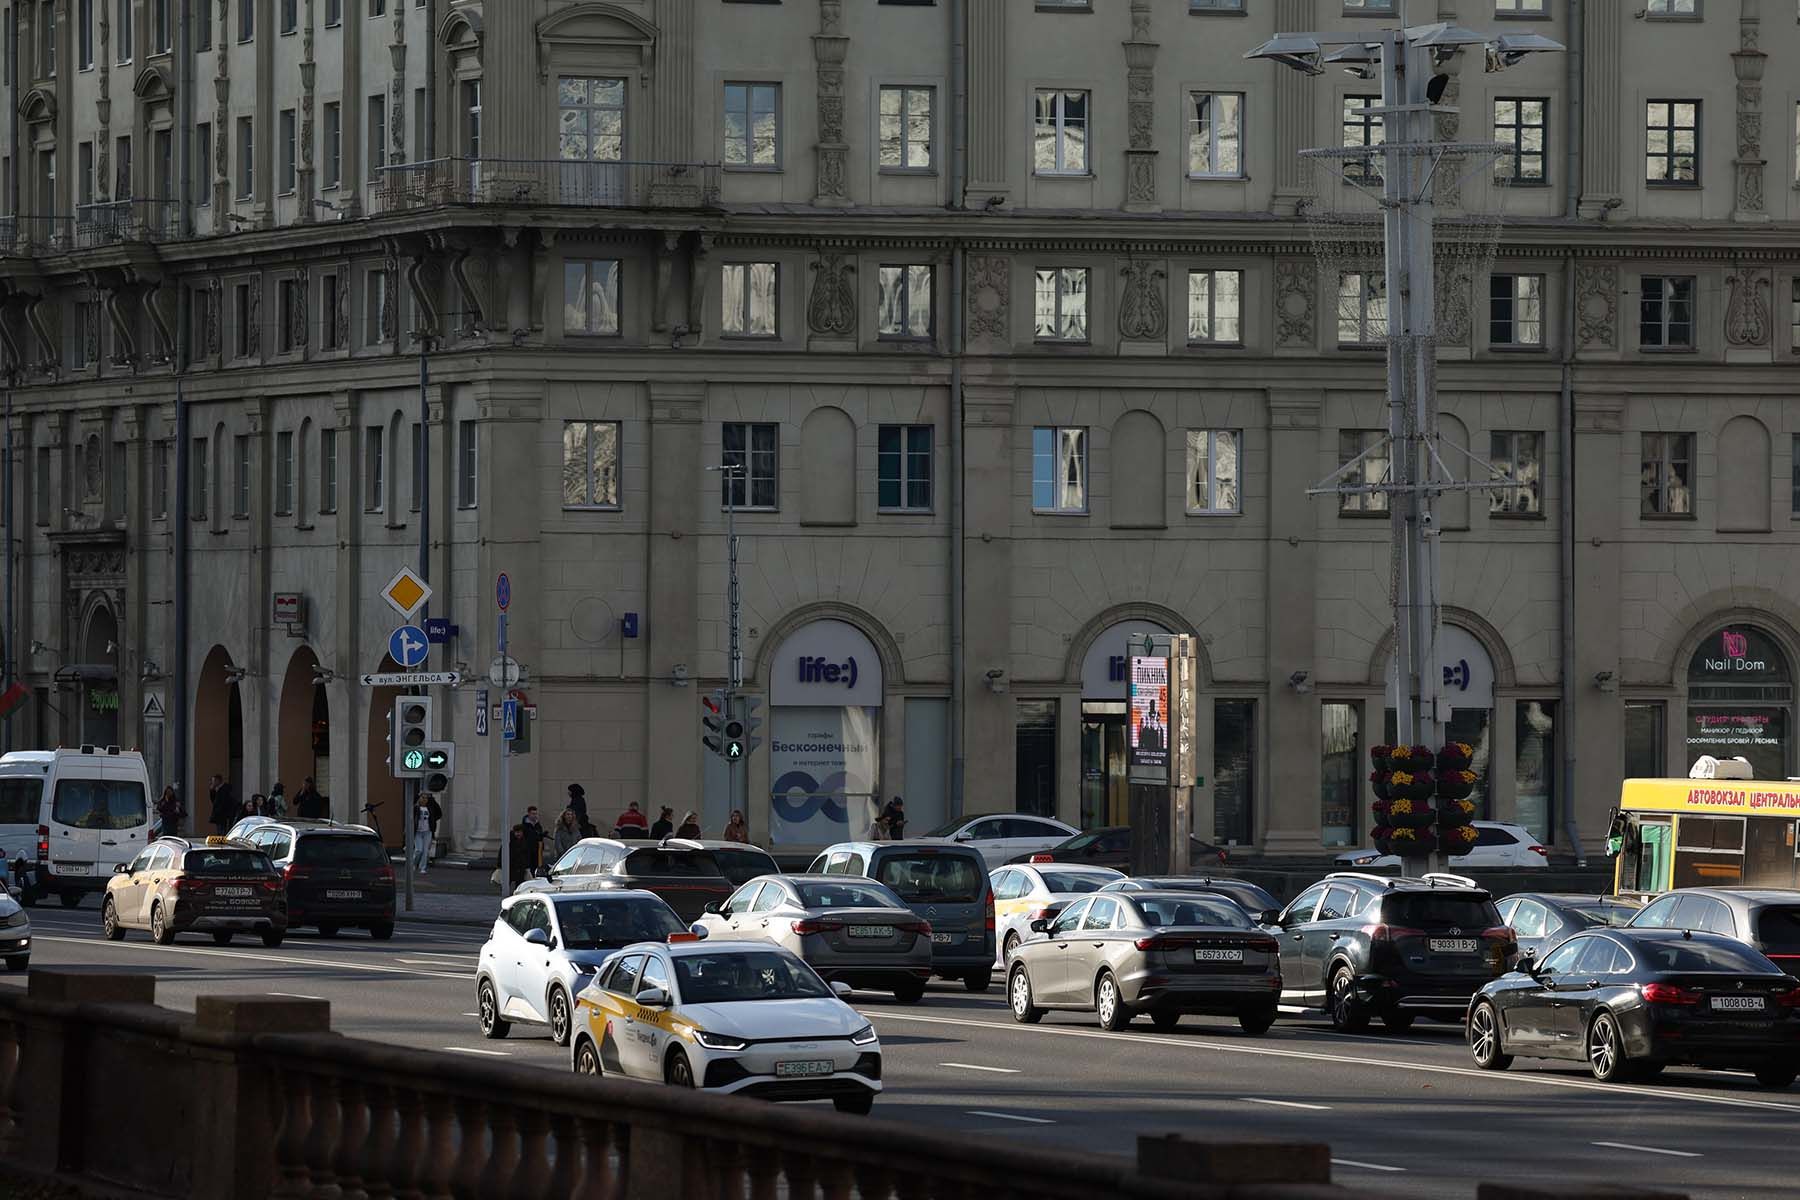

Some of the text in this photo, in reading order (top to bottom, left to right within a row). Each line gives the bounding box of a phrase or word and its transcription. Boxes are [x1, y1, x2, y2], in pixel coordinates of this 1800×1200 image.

[1705, 658, 1765, 671] Nail Dom
[798, 656, 858, 688] life:)
[395, 674, 442, 683] ЭНГЕЛЬСА
[1735, 727, 1764, 735] ПЕДИКЮР
[1686, 737, 1726, 745] ОФОРМЛЕНИЕ
[1727, 736, 1750, 745] БРОВЕЙ
[1687, 789, 1800, 809] АВТОВОКЗАЛ ЦЕНТРАЛЬН
